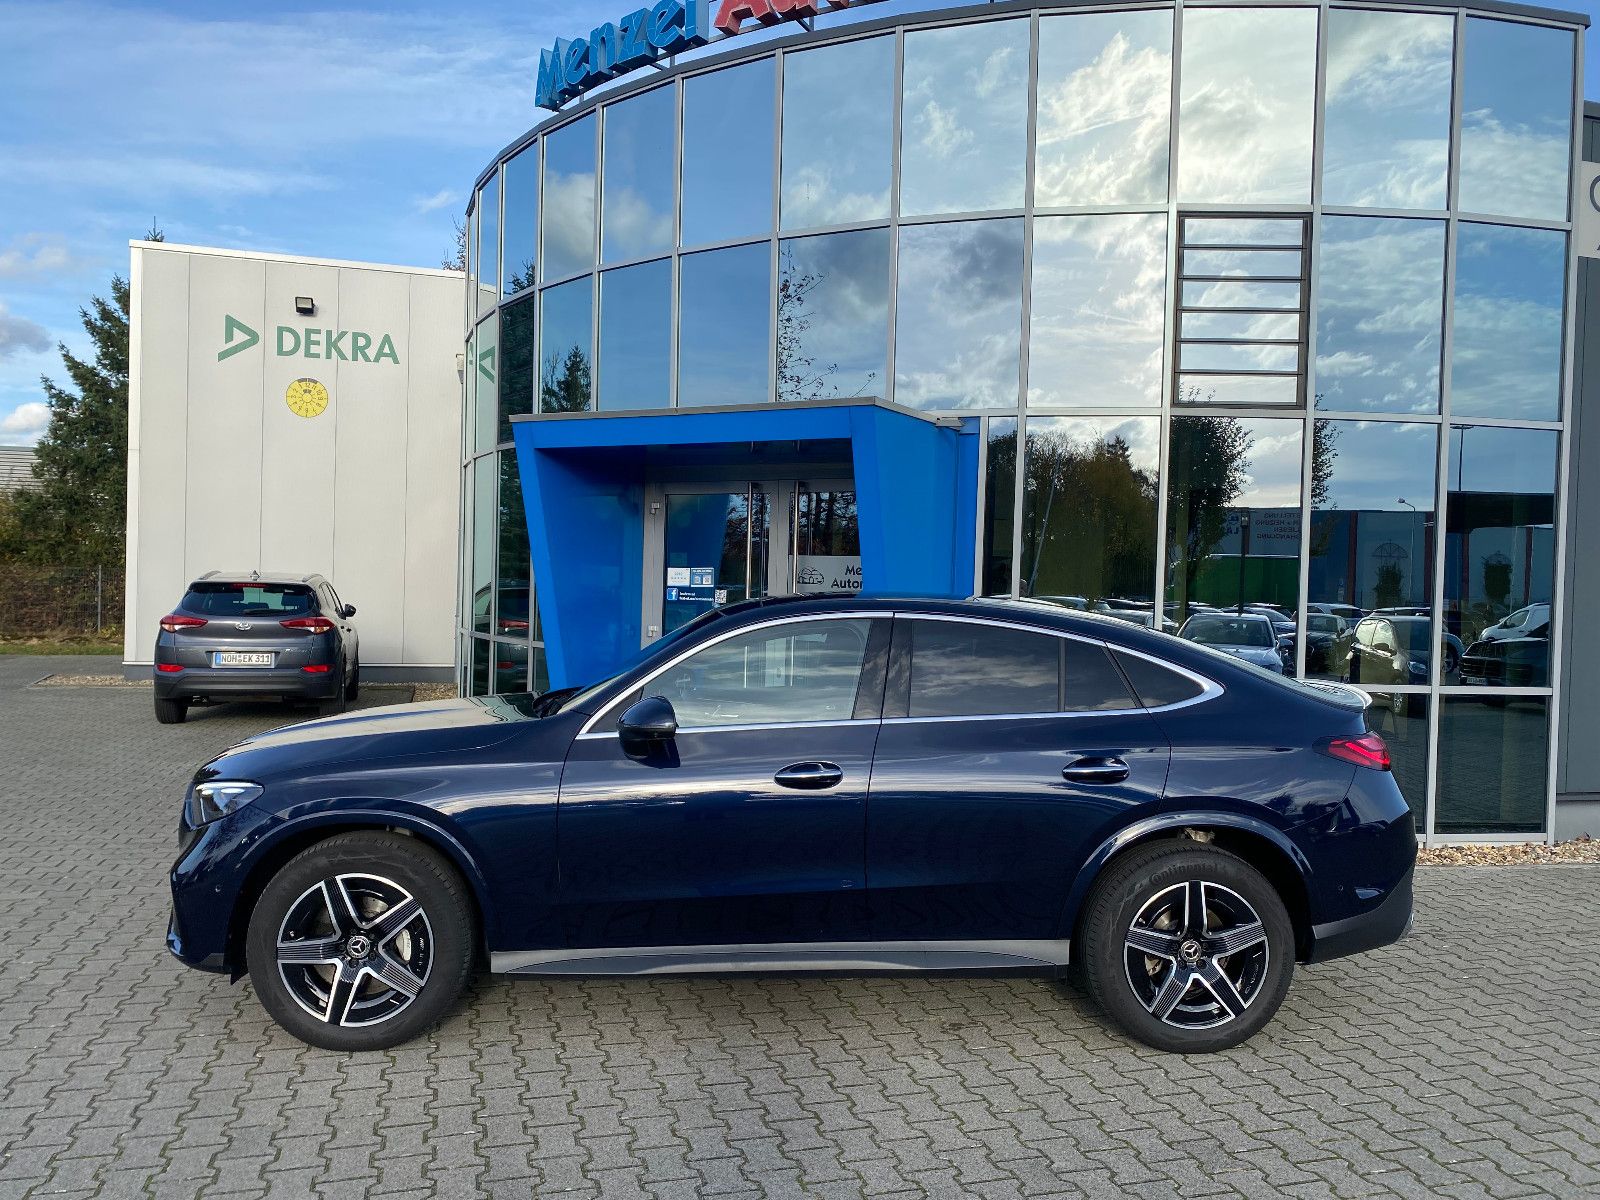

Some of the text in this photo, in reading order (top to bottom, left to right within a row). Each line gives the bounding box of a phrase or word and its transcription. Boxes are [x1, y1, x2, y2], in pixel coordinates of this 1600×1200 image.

[535, 0, 706, 109] Menzel
[276, 325, 400, 364] DEKRA
[221, 654, 270, 663] NOH EK 311
